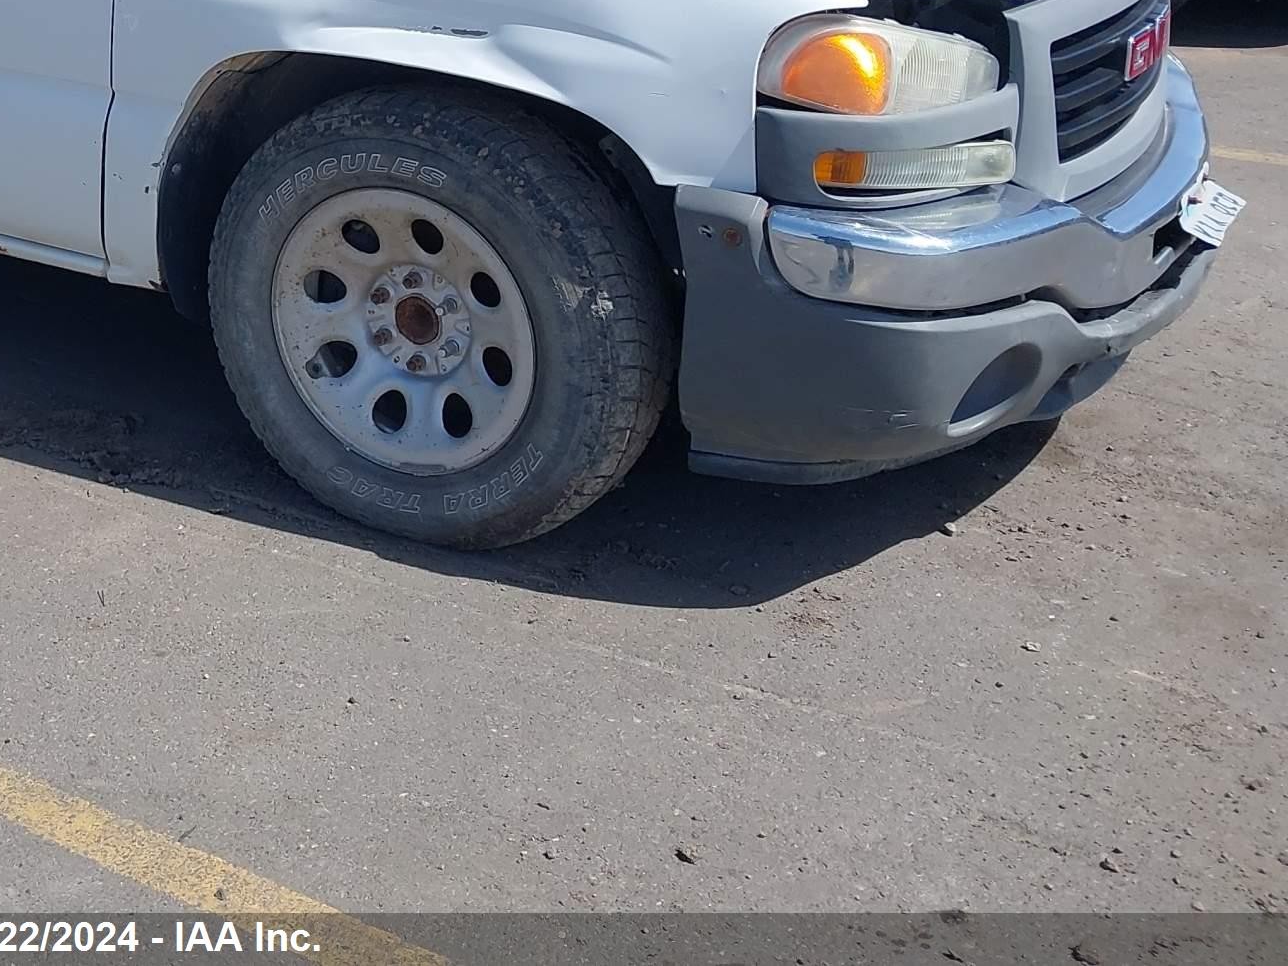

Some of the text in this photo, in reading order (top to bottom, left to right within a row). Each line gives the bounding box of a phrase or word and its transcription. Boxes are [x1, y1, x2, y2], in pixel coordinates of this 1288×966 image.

[1124, 4, 1171, 81] GM
[258, 153, 448, 227] HERCULES
[326, 442, 544, 515] TERRA TRAC
